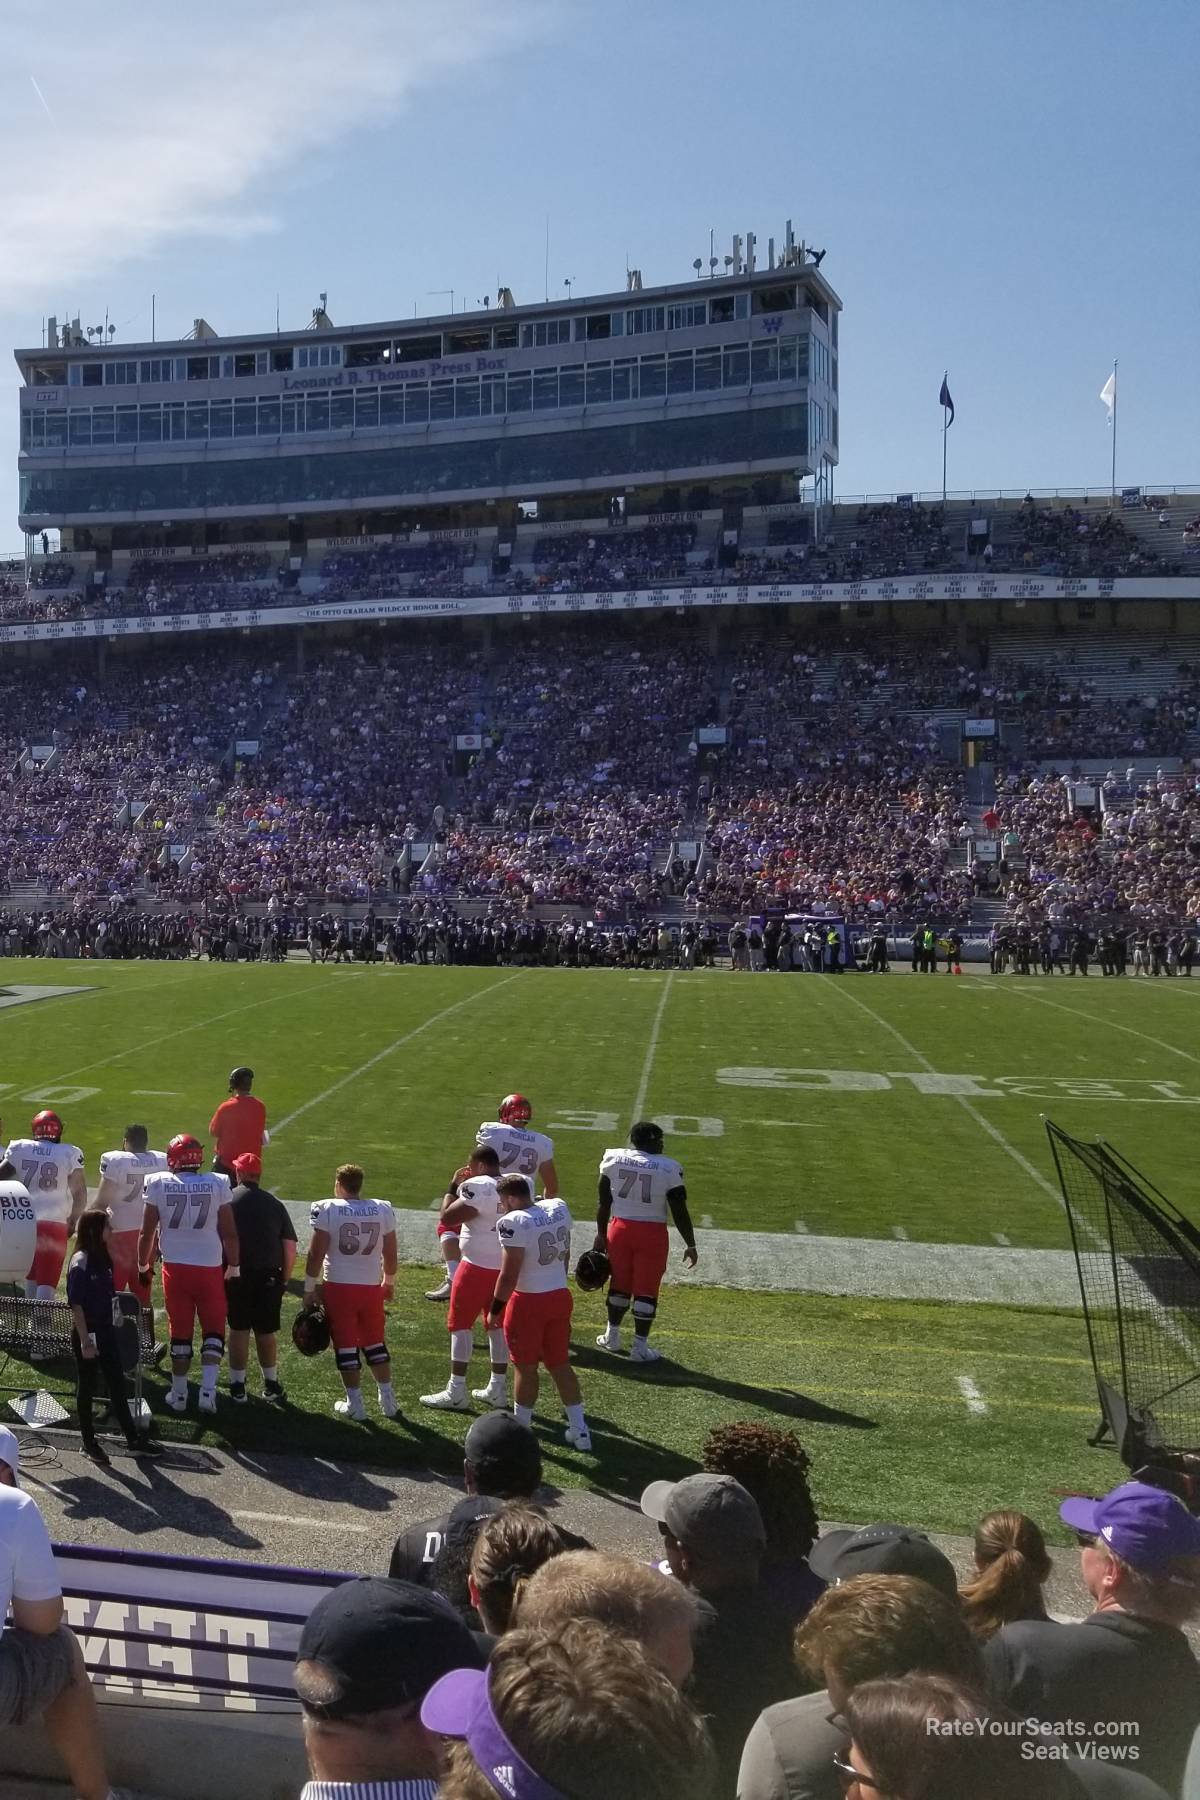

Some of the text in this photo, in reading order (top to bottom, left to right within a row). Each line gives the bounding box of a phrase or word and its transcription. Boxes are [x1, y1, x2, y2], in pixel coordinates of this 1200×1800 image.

[282, 357, 506, 390] Leonard B. Thomas Press Box
[343, 607, 376, 615] GRAHAM
[378, 605, 409, 613] WILDCAT
[547, 1099, 725, 1137] 30
[500, 1142, 538, 1175] 73
[21, 1159, 60, 1192] 78
[164, 1182, 213, 1193] McCULLOUGH
[618, 1168, 652, 1203] 71
[2, 1208, 35, 1221] FOGG
[166, 1194, 212, 1230] 77
[338, 1205, 379, 1217] REYNOLDS
[338, 1222, 381, 1256] 67
